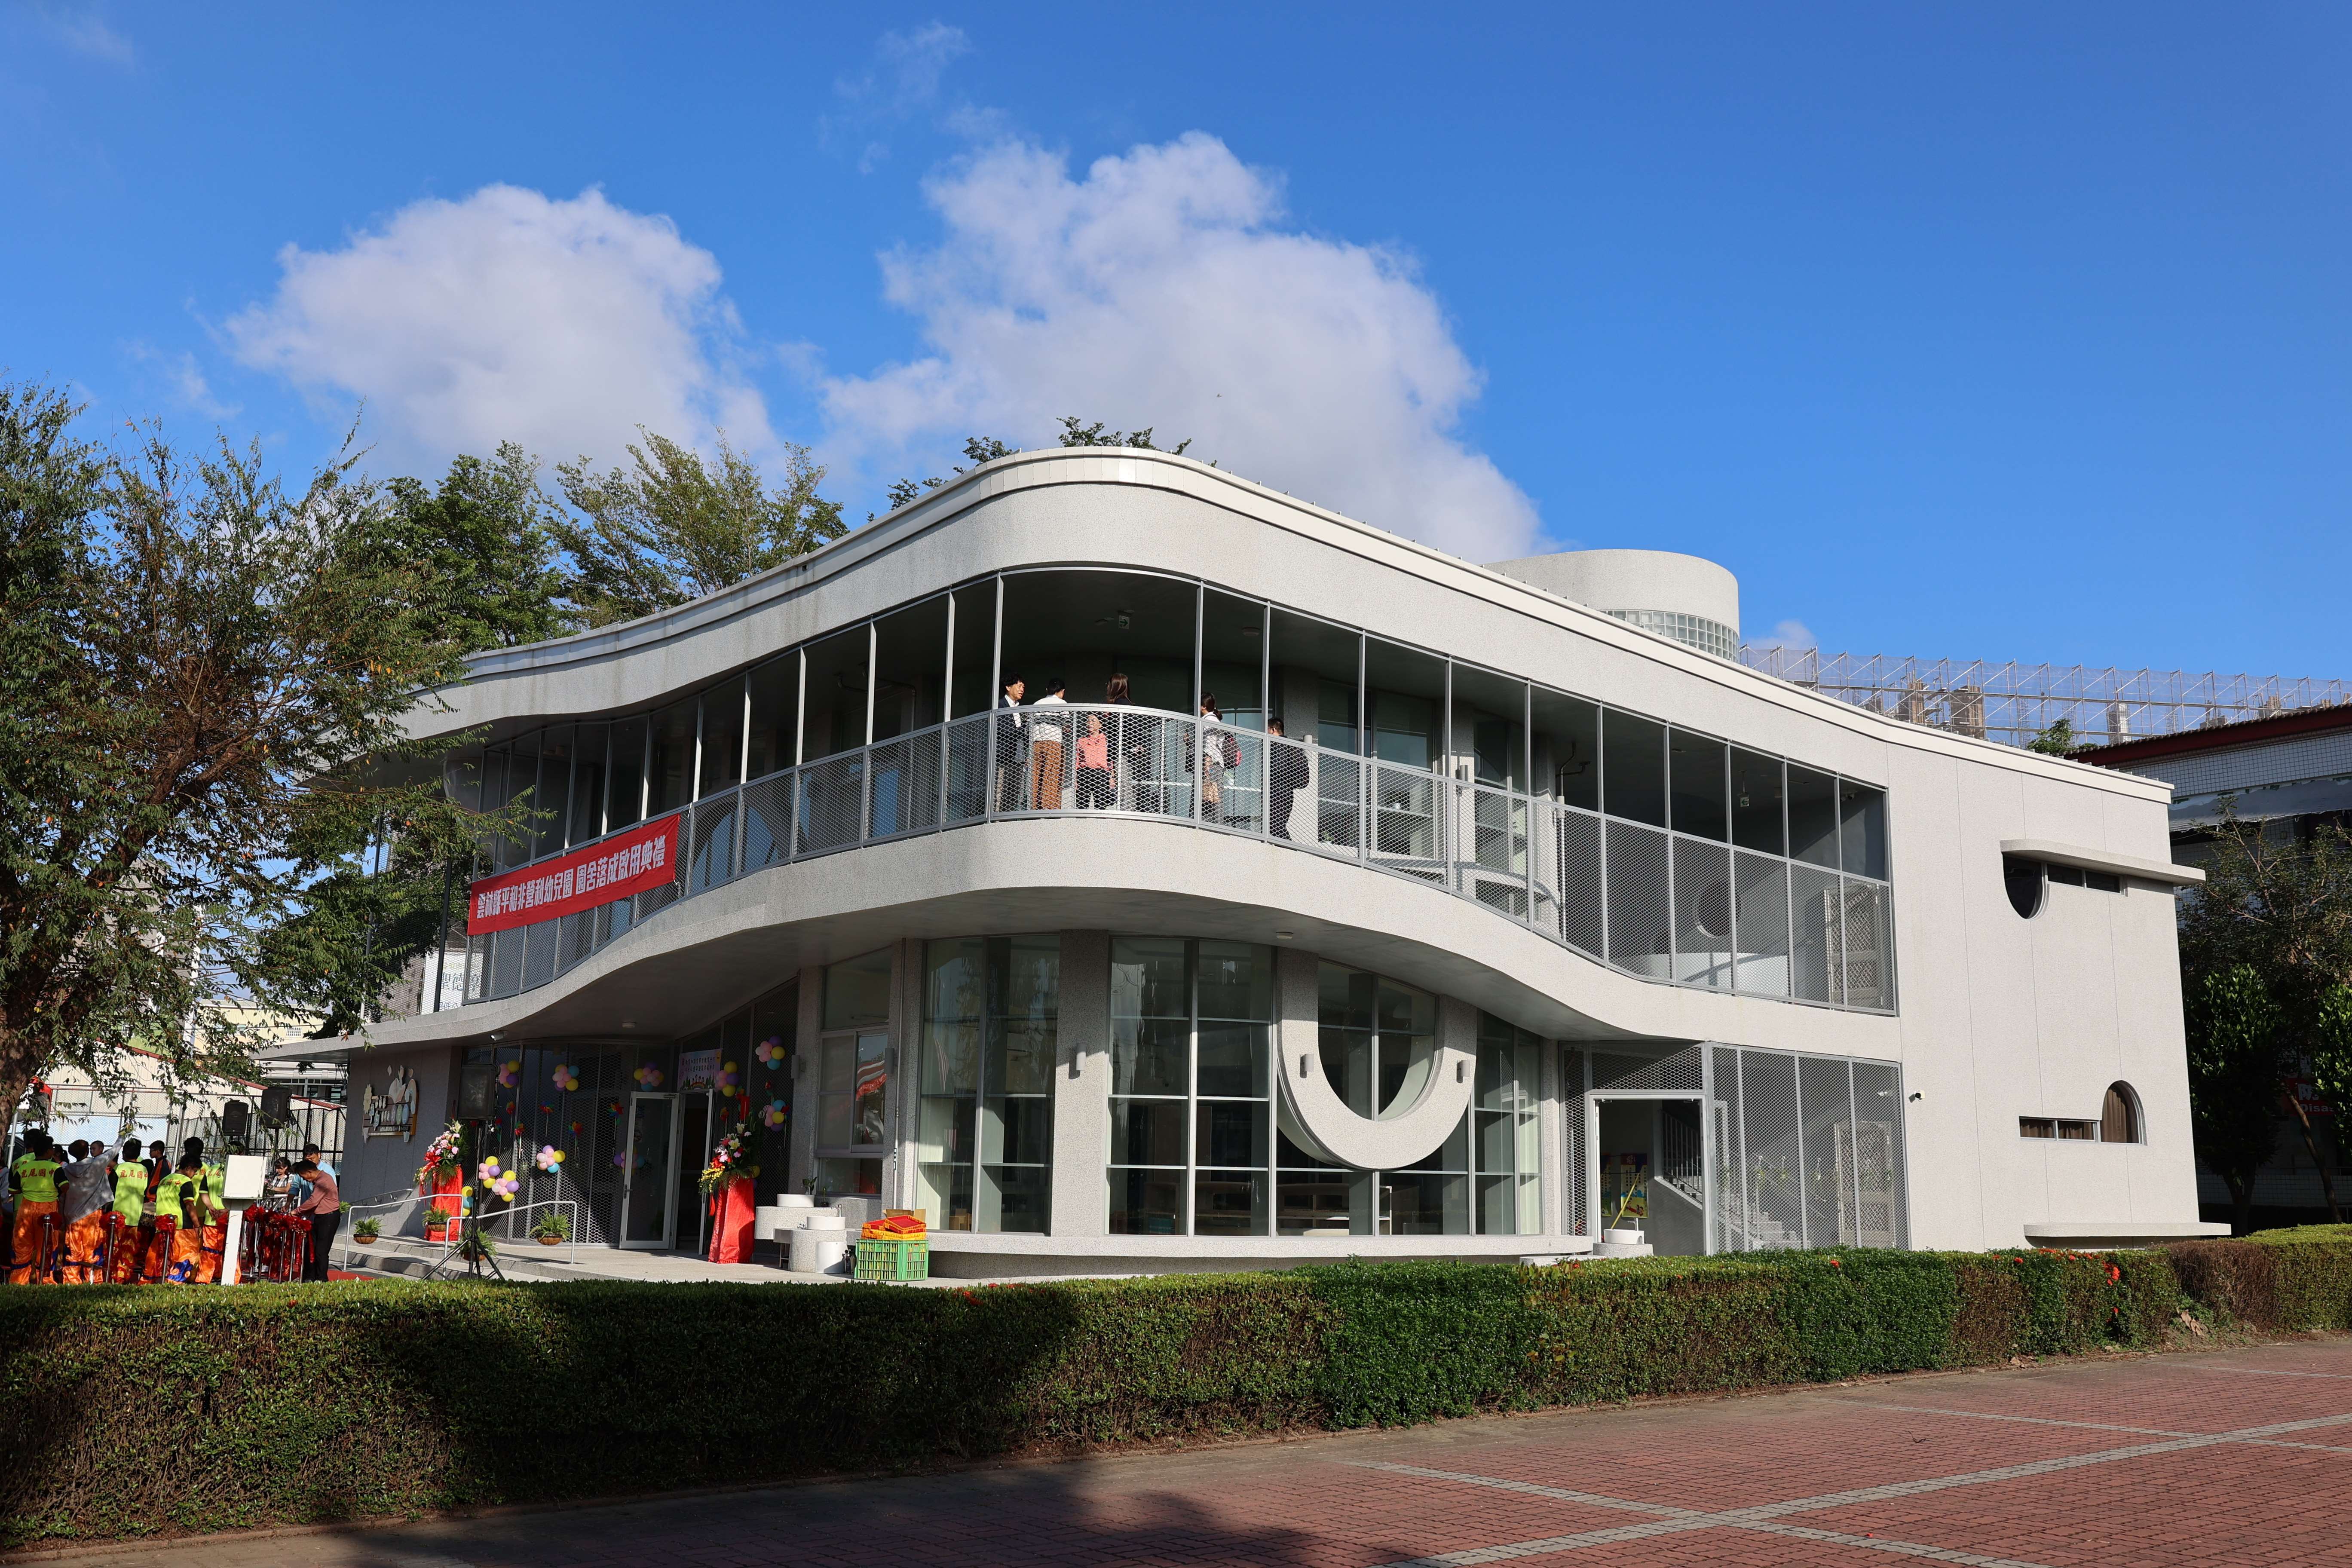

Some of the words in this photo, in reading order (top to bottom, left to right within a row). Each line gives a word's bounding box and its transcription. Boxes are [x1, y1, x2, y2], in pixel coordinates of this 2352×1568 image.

[477, 868, 573, 919] 雲林縣平和非營利幼兒園
